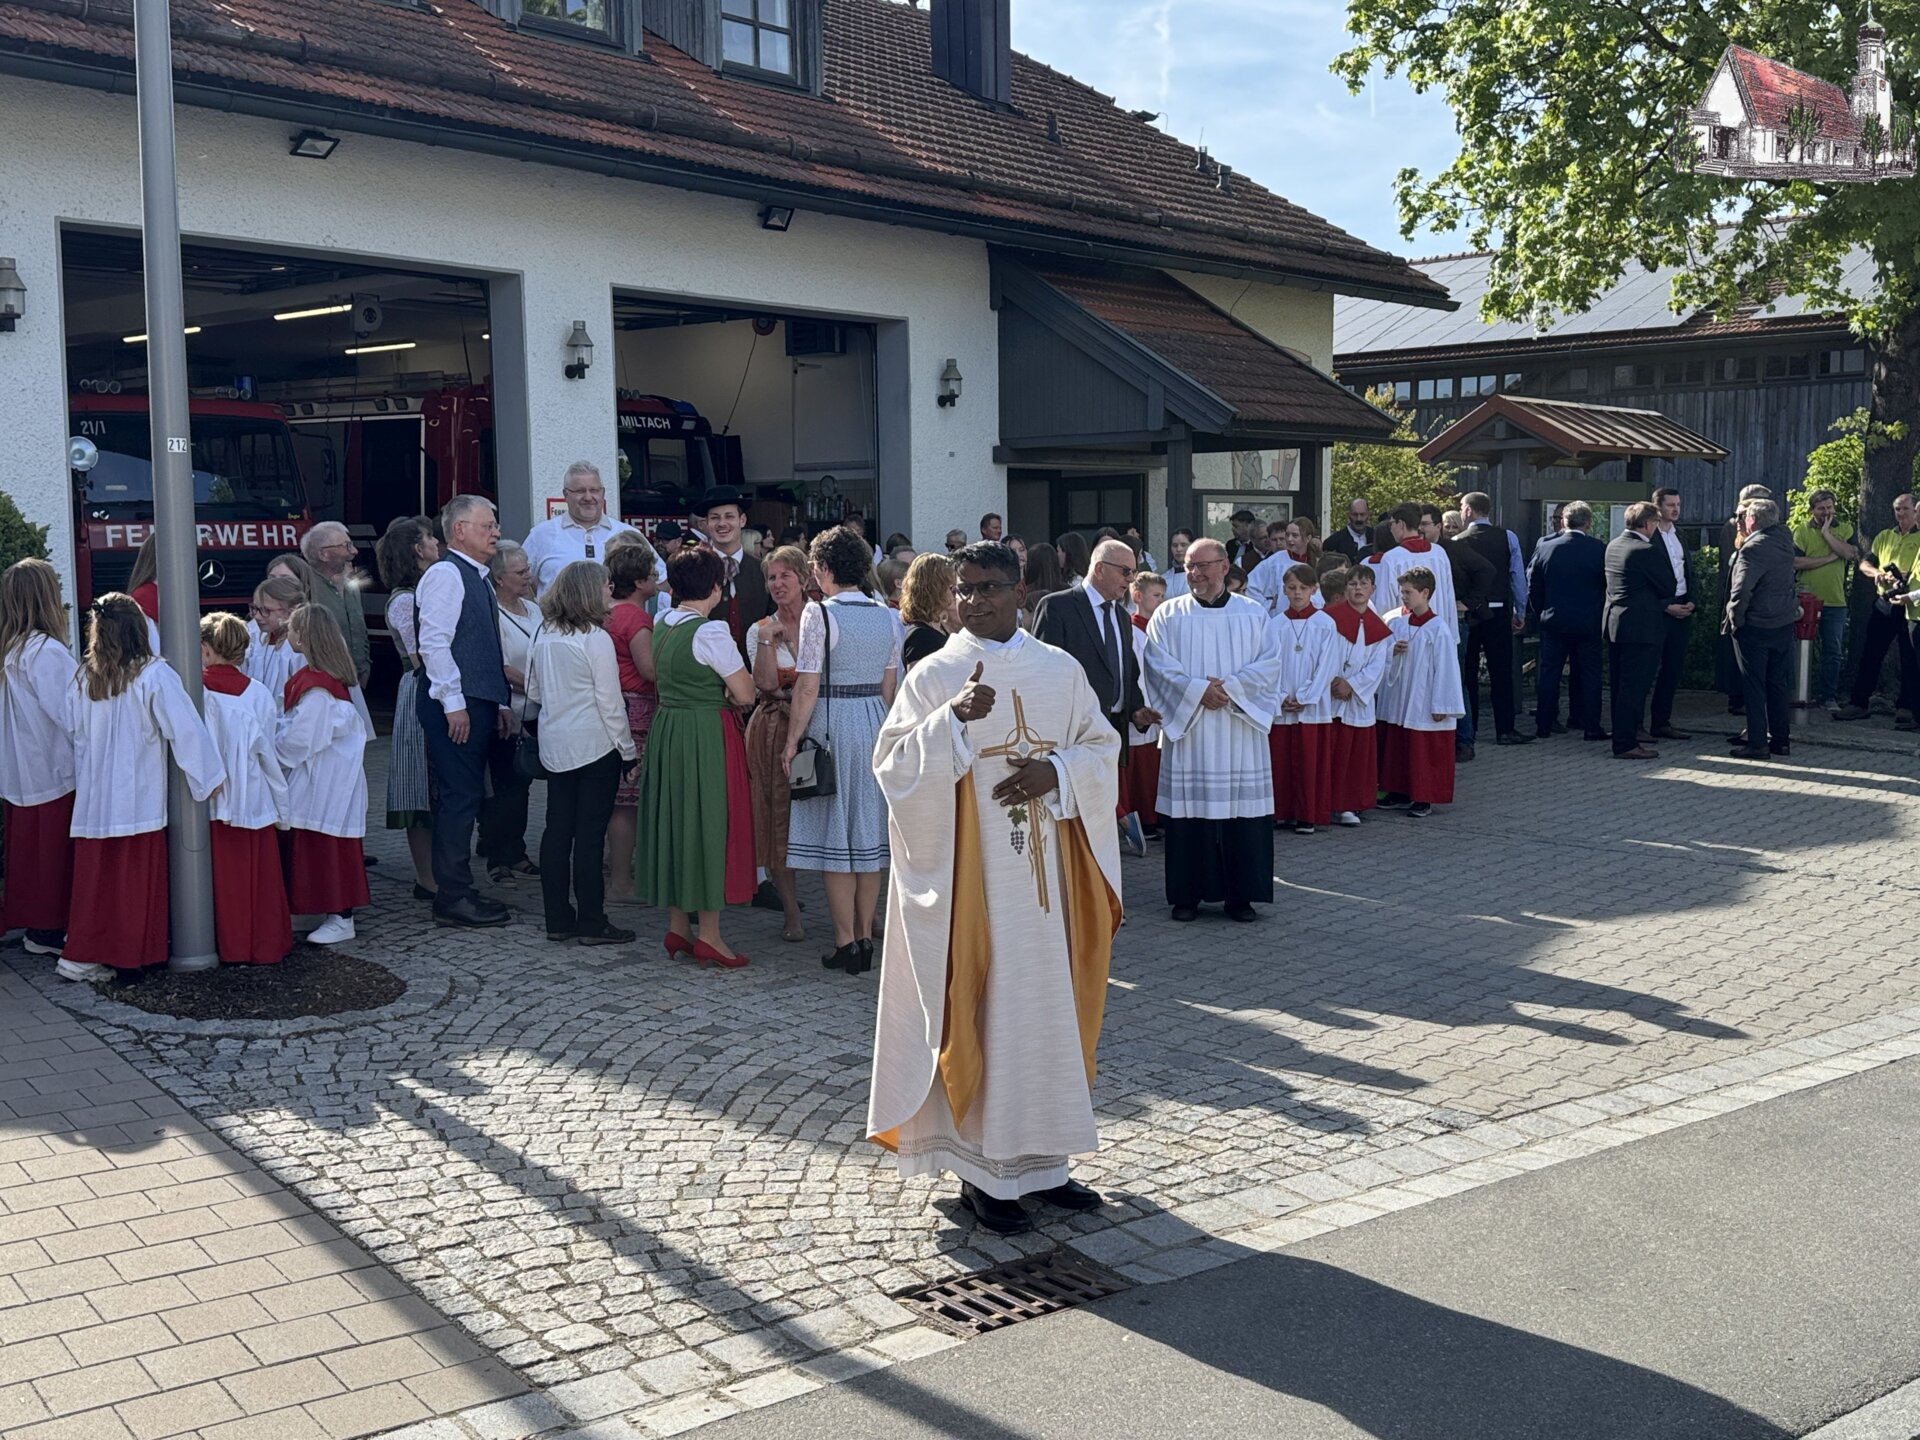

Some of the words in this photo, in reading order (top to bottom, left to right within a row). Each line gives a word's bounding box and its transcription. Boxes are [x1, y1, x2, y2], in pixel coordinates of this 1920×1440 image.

[80, 420, 106, 436] 21/1
[620, 415, 671, 430] MILTACH
[168, 439, 186, 451] 212
[105, 524, 298, 548] FERWEHR
